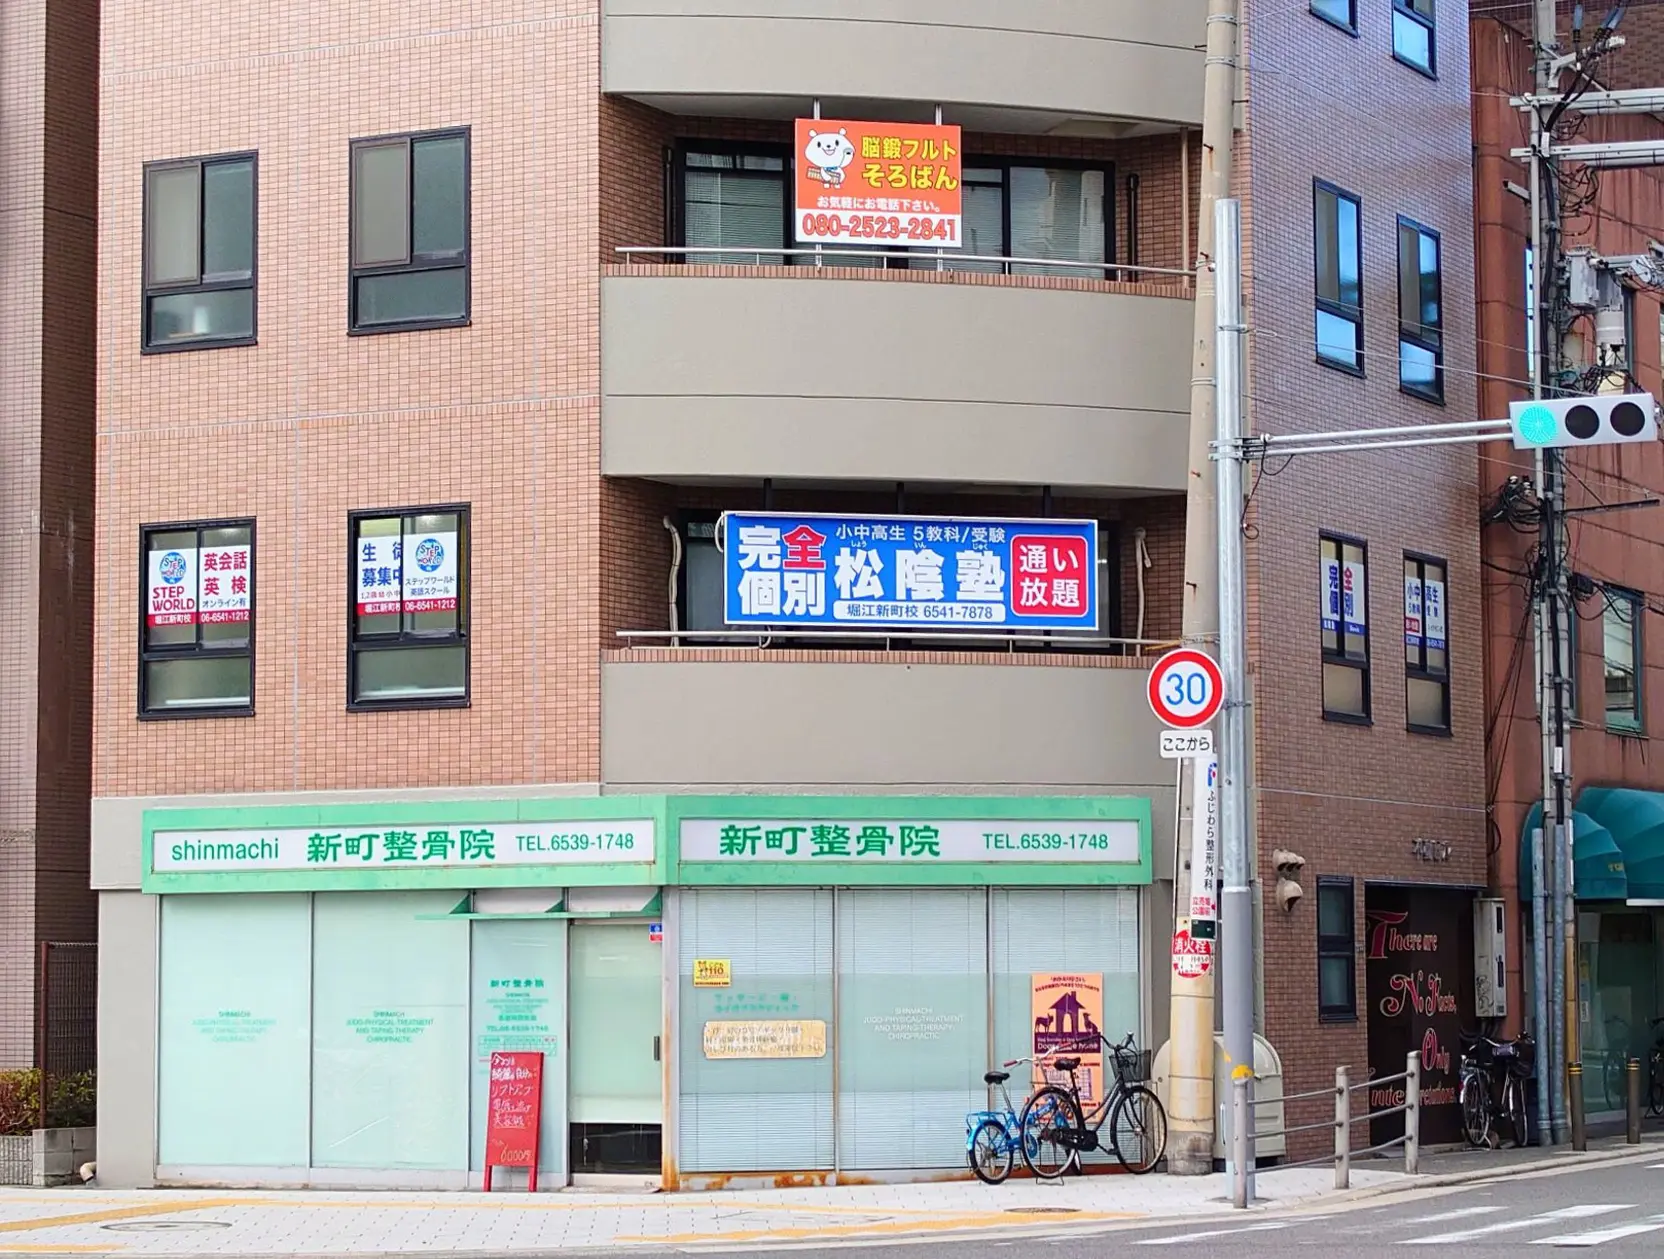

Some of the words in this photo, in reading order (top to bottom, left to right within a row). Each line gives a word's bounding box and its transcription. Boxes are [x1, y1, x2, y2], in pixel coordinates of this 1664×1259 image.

[862, 136, 957, 160] 脳鍛フルト
[862, 163, 958, 190] そろばん
[817, 196, 940, 212] お気軽にお電話下さい。
[802, 213, 956, 240] 080-2523-2841
[835, 524, 906, 541] 小中高生
[913, 526, 1005, 543] 5教科/受験
[738, 525, 827, 570] 完全
[204, 551, 247, 571] 英会話
[1019, 544, 1079, 574] 通い
[405, 575, 455, 586] ステップワールド
[834, 547, 1005, 601] 松陰塾
[152, 586, 184, 599] STEP
[204, 576, 247, 596] 英検
[737, 570, 826, 616] 個別
[1019, 577, 1080, 608] 放題
[152, 598, 195, 611] WORLD
[404, 600, 456, 611] 06-6541-1212
[847, 604, 918, 618] 堀江新町校
[924, 605, 993, 620] 6541-7878
[201, 611, 249, 622] 06-6541-1212
[1166, 672, 1206, 706] 30
[1163, 736, 1210, 751] ここから
[172, 837, 279, 861] shinmachi
[307, 829, 496, 863] 新町整骨院
[516, 833, 634, 852] TEL.6539-1748
[719, 824, 941, 857] 新町整骨院
[982, 833, 1109, 850] TEL.6539-1748
[1203, 790, 1217, 891] ふじわら整形外科
